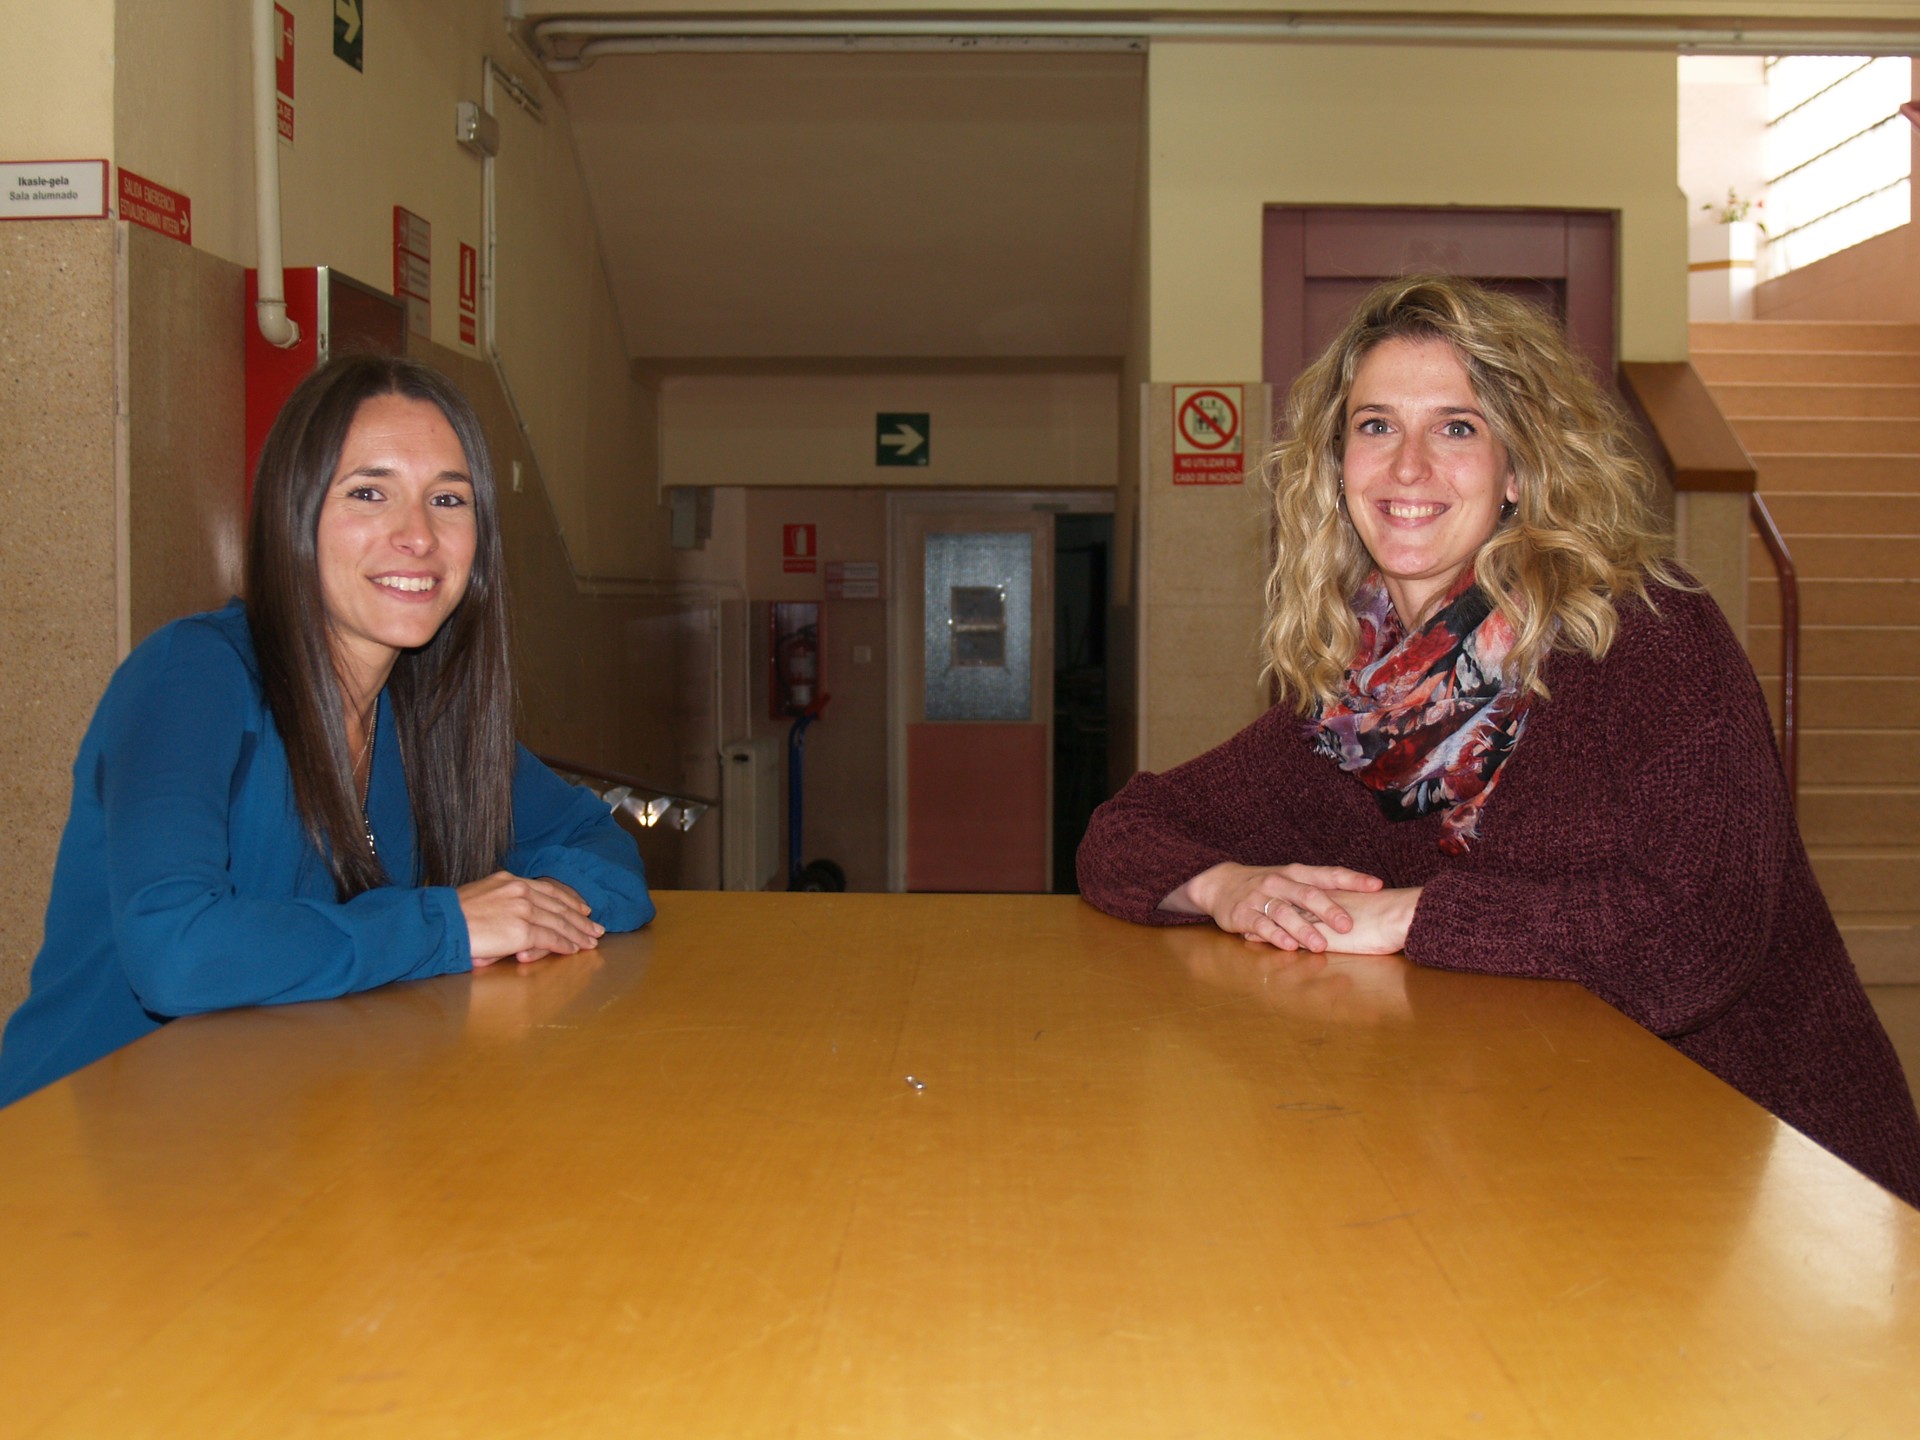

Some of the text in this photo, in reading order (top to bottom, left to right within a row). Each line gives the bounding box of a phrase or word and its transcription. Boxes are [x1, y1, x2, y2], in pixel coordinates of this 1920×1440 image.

[18, 176, 69, 188] Ikasle-gela
[9, 190, 78, 200] Sala alumnado
[124, 176, 175, 213] SALIDA EMERGENCIA
[1181, 458, 1237, 468] NO UTILIZAR EN
[1174, 472, 1195, 482] CASO
[1197, 472, 1206, 482] DE
